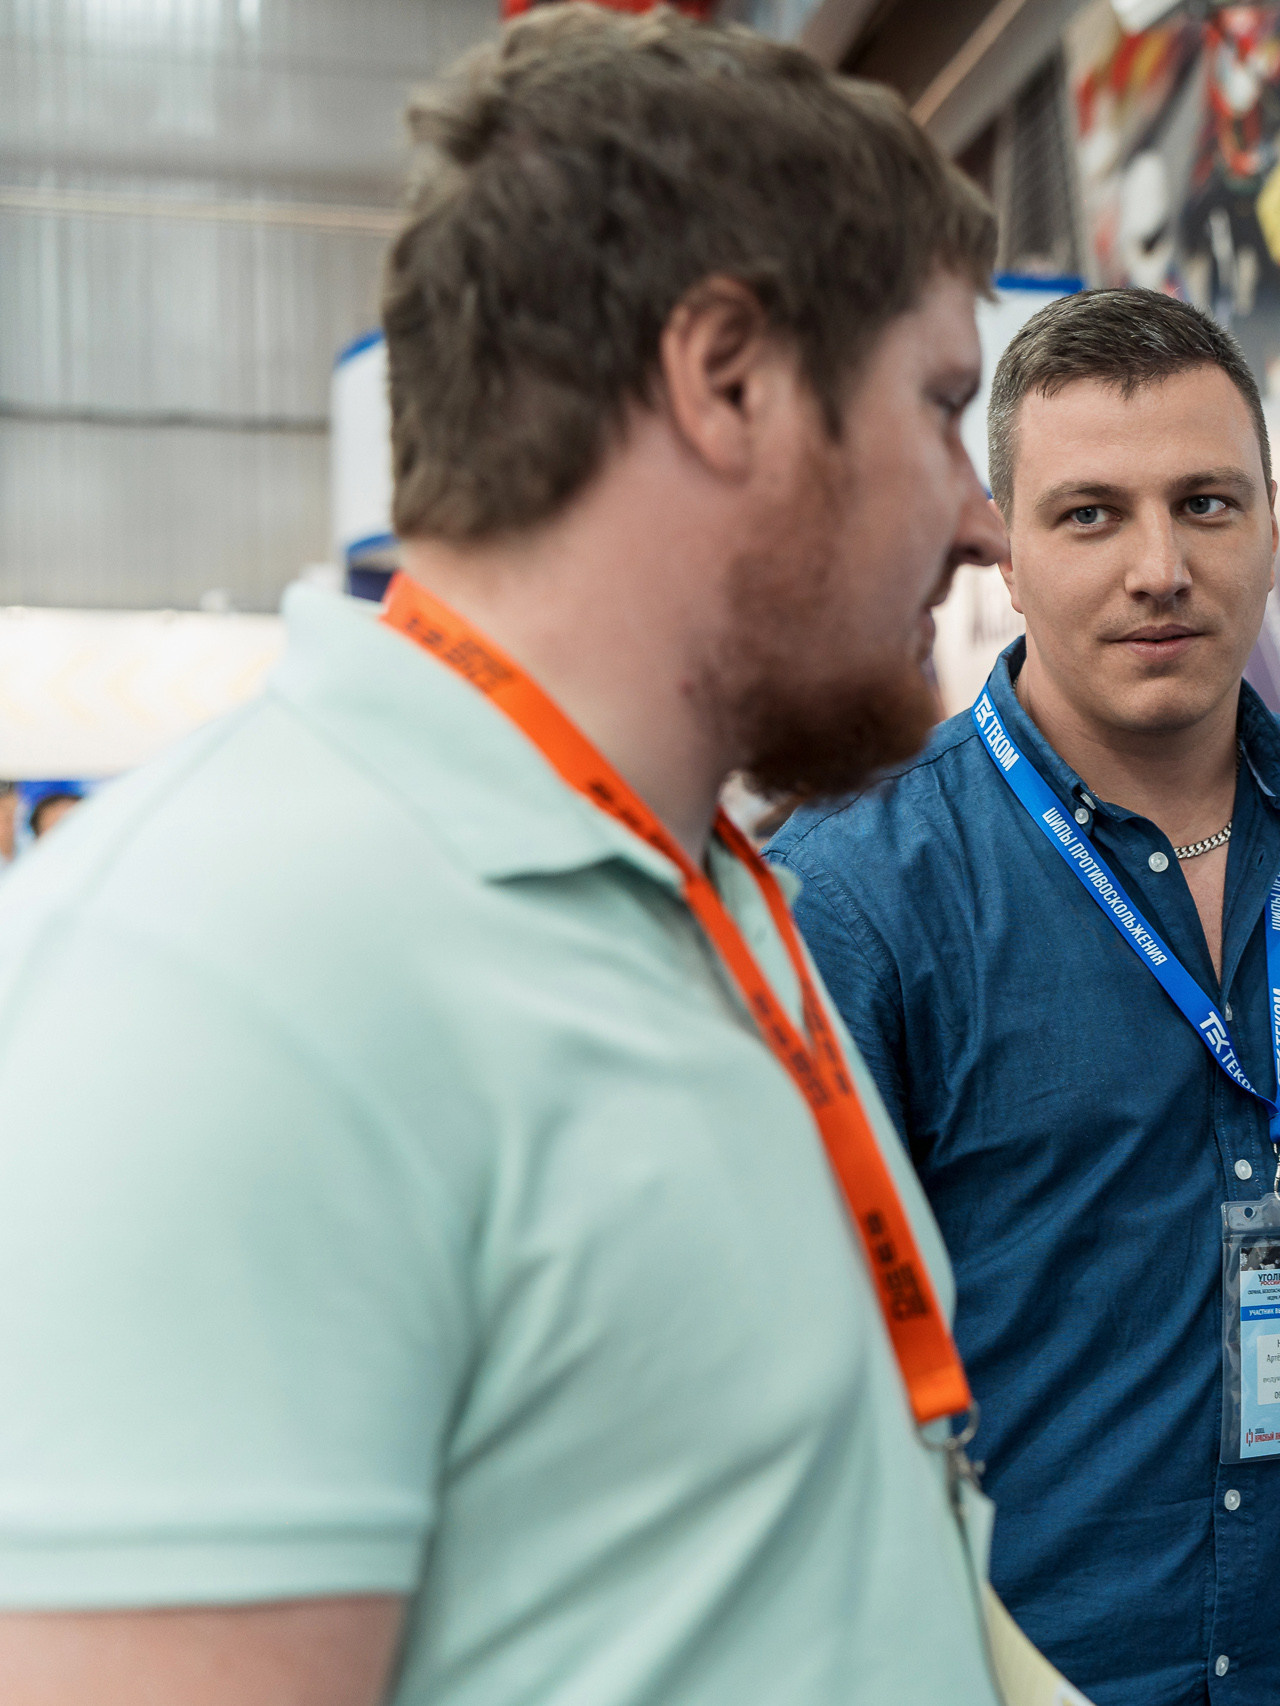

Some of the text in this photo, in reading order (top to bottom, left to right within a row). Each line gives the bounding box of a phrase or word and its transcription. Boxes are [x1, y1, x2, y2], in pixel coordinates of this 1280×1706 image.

[984, 716, 1020, 771] ТЕКОМ
[1042, 807, 1168, 966] ШИПЫ ПРОТИВОСКОЛЬЖЕНИЯ
